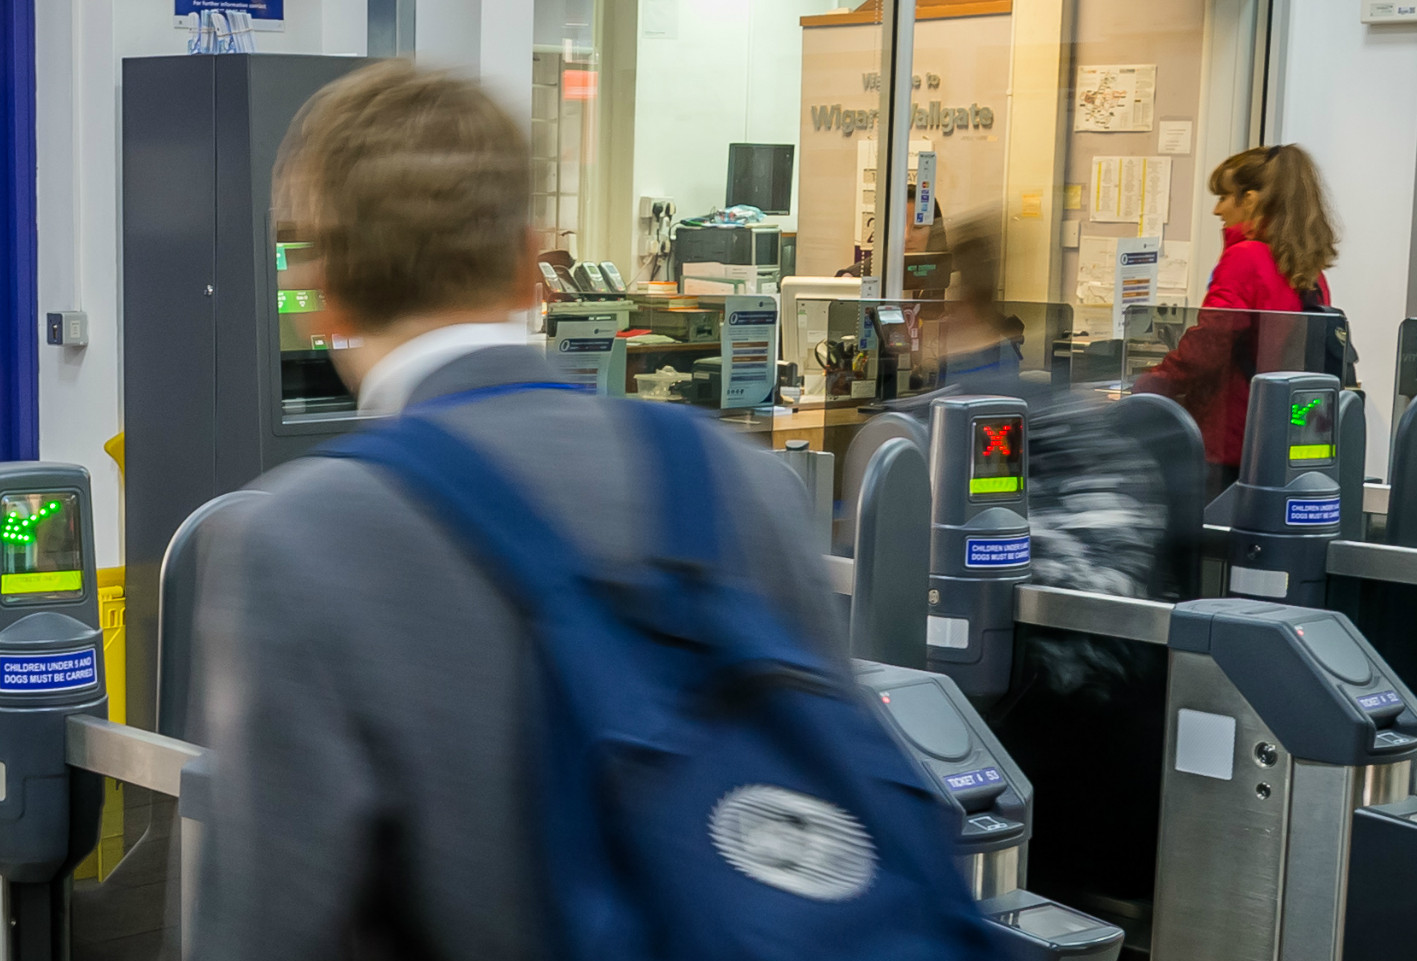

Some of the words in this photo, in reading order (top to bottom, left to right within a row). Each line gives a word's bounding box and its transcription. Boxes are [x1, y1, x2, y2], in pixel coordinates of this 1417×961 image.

[926, 73, 940, 88] to
[4, 663, 45, 672] CHILDREN
[47, 661, 75, 671] UNDER
[75, 660, 79, 668] 5
[80, 657, 92, 667] AND
[4, 674, 28, 683] DOGS
[29, 674, 52, 683] MUST
[54, 673, 65, 682] BE
[66, 668, 93, 680] CARRIED
[947, 775, 975, 787] TICKET
[985, 770, 1000, 780] 53
